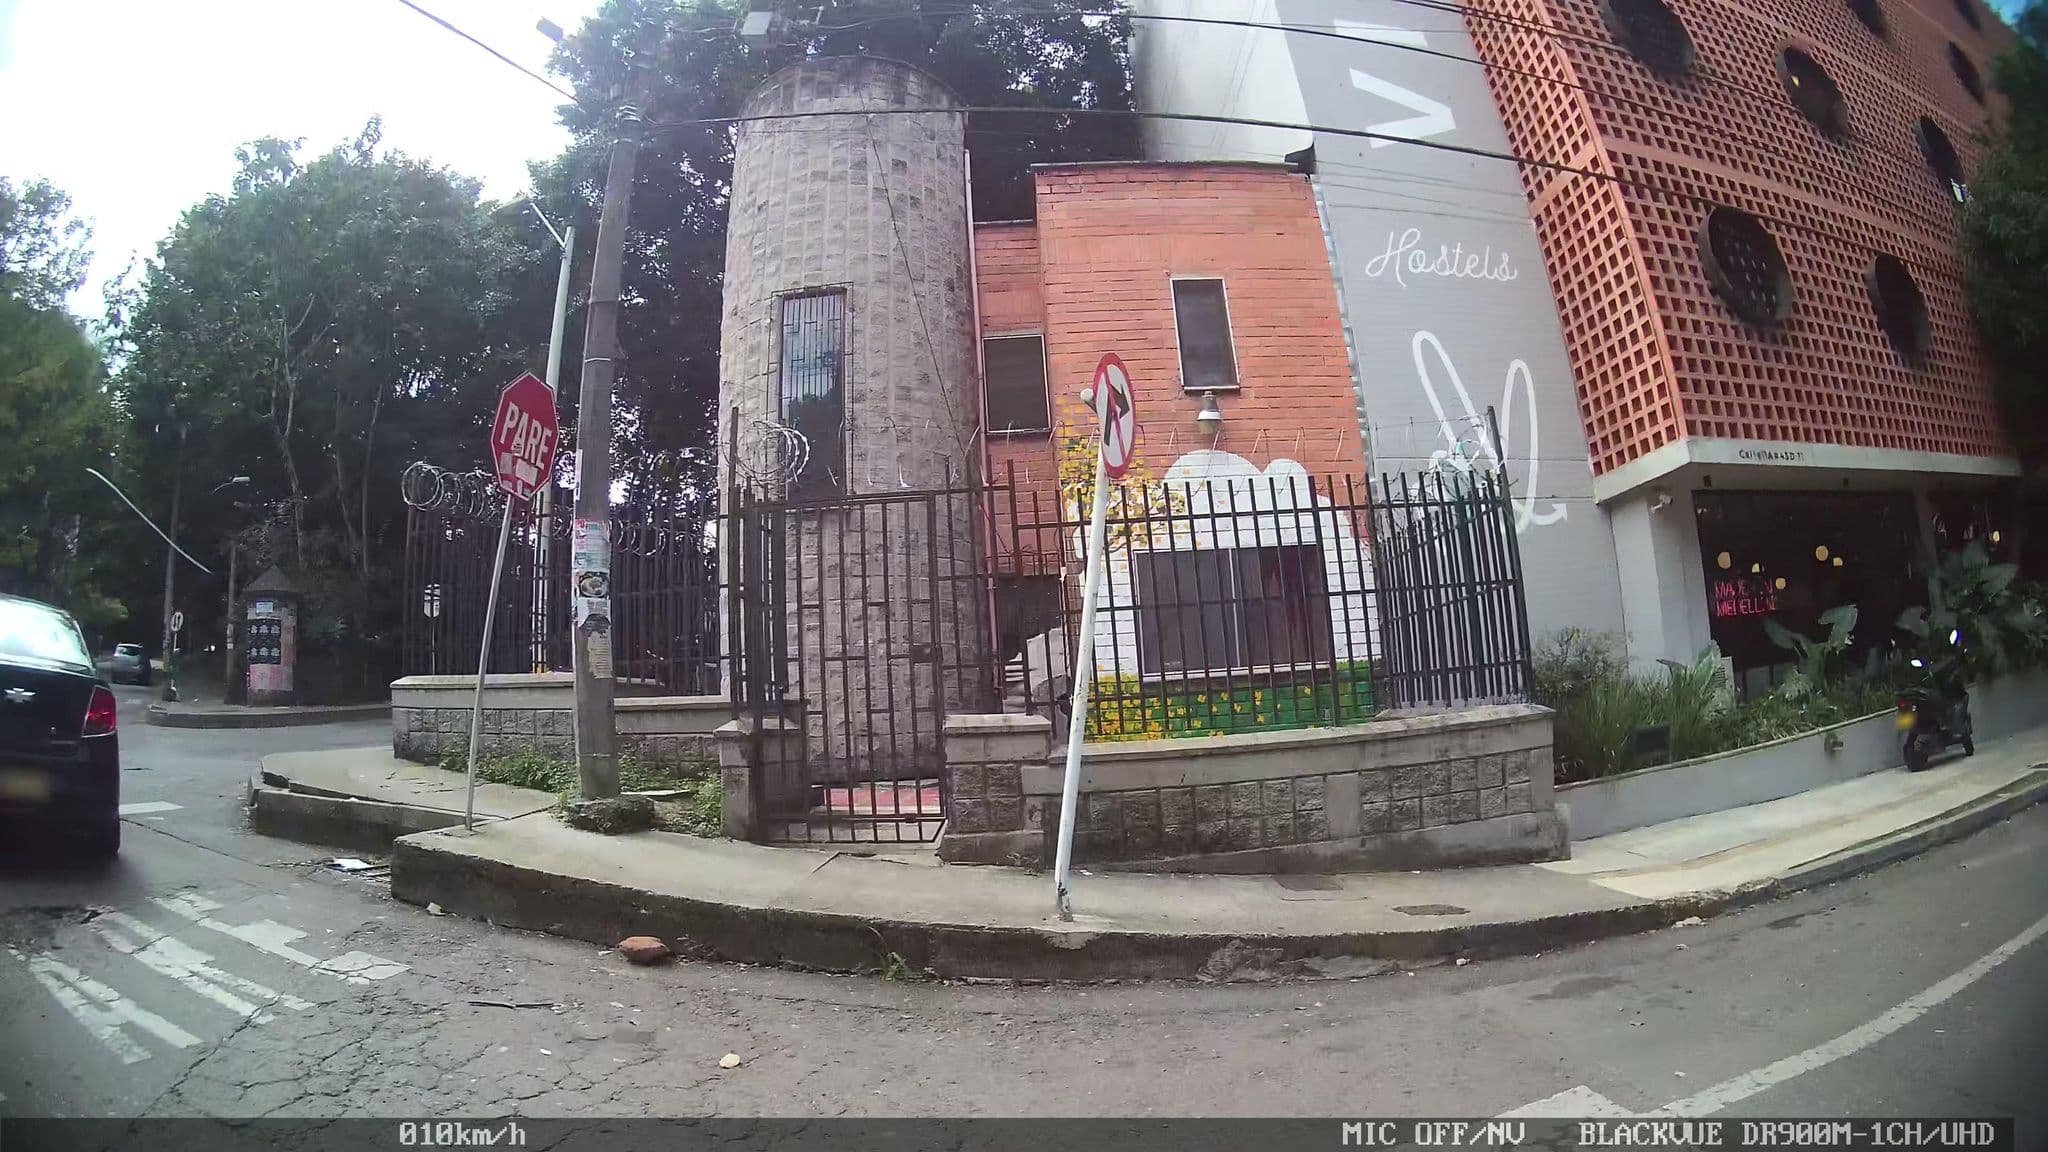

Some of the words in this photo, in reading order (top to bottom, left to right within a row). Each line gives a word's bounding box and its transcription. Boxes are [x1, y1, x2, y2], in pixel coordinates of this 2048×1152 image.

[1365, 227, 1519, 288] Hostels
[500, 401, 553, 470] PARE
[1716, 593, 1777, 617] MEELLN
